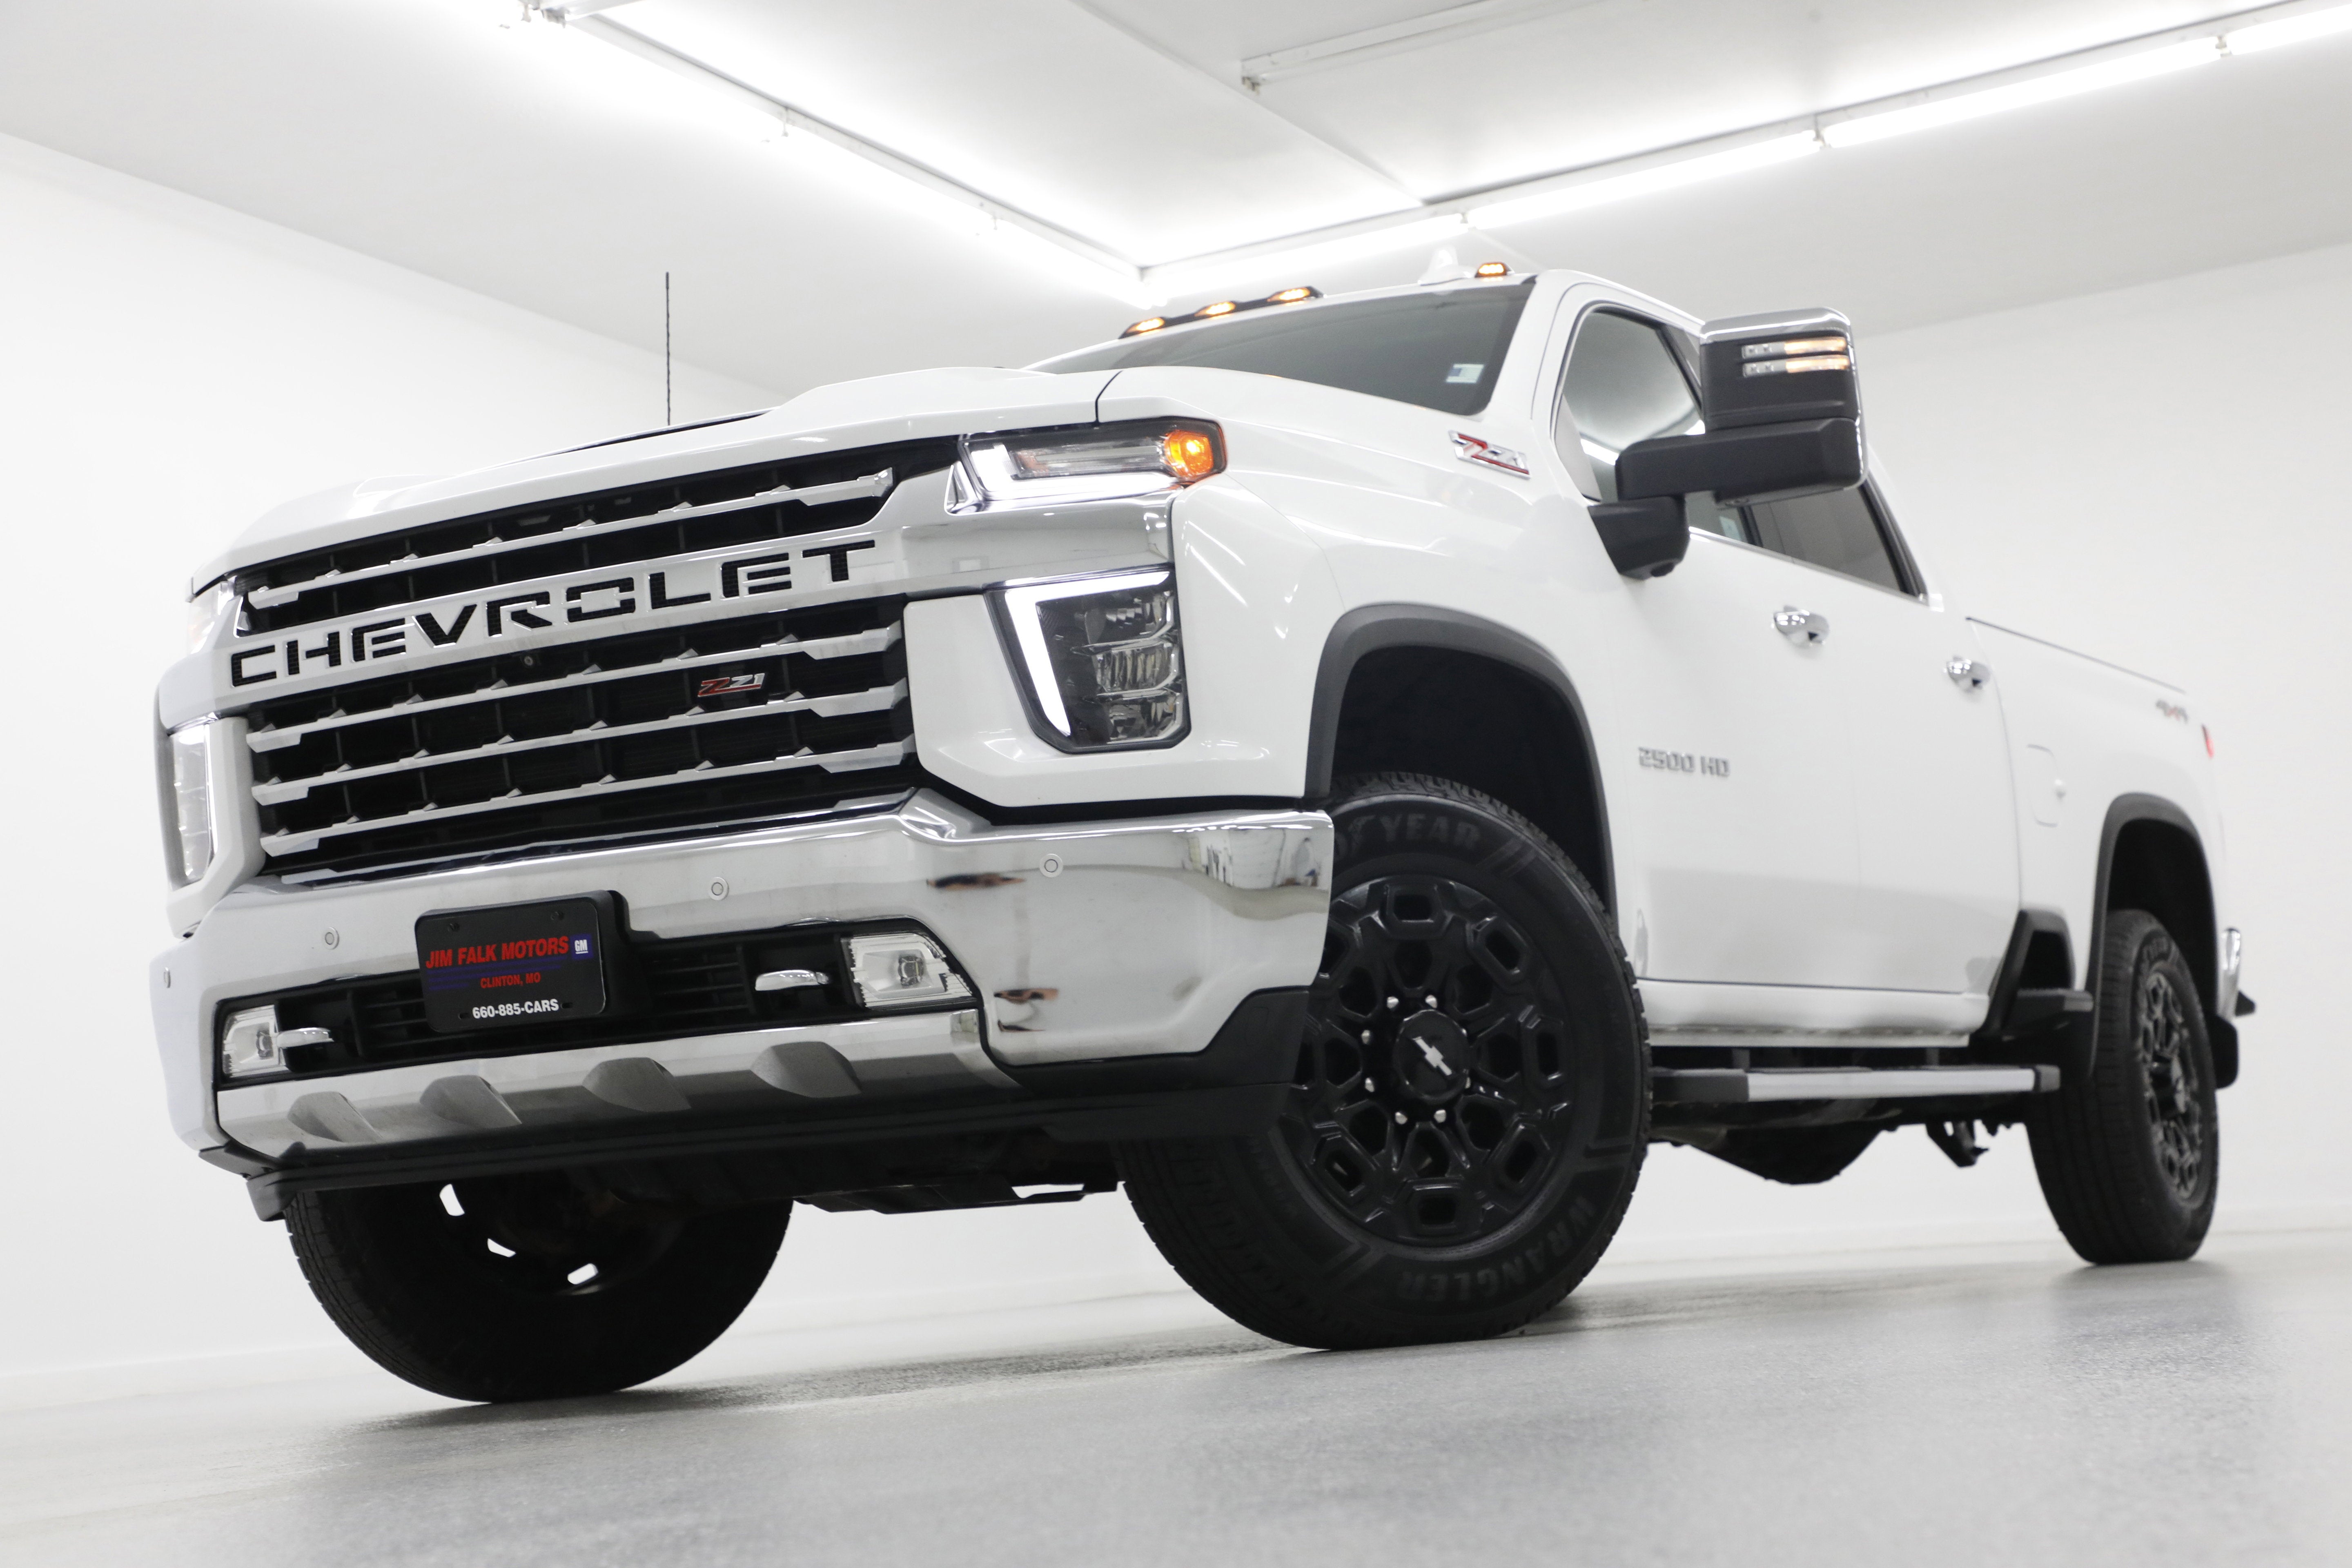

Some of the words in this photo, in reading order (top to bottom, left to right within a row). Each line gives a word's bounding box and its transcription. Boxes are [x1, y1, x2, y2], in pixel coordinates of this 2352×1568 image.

[231, 539, 875, 688] CHEVROLET
[697, 673, 765, 697] Z71
[1638, 746, 1695, 773] 2500
[1700, 755, 1730, 777] HD
[426, 949, 452, 969] JIM
[458, 944, 497, 965] FALK
[502, 936, 569, 960] MOTORS
[574, 939, 588, 952] GM
[480, 974, 523, 989] CLINTON,
[526, 972, 541, 983] MO
[472, 999, 559, 1019] 660-885-CARS
[1396, 1196, 1594, 1302] WRANGLER
